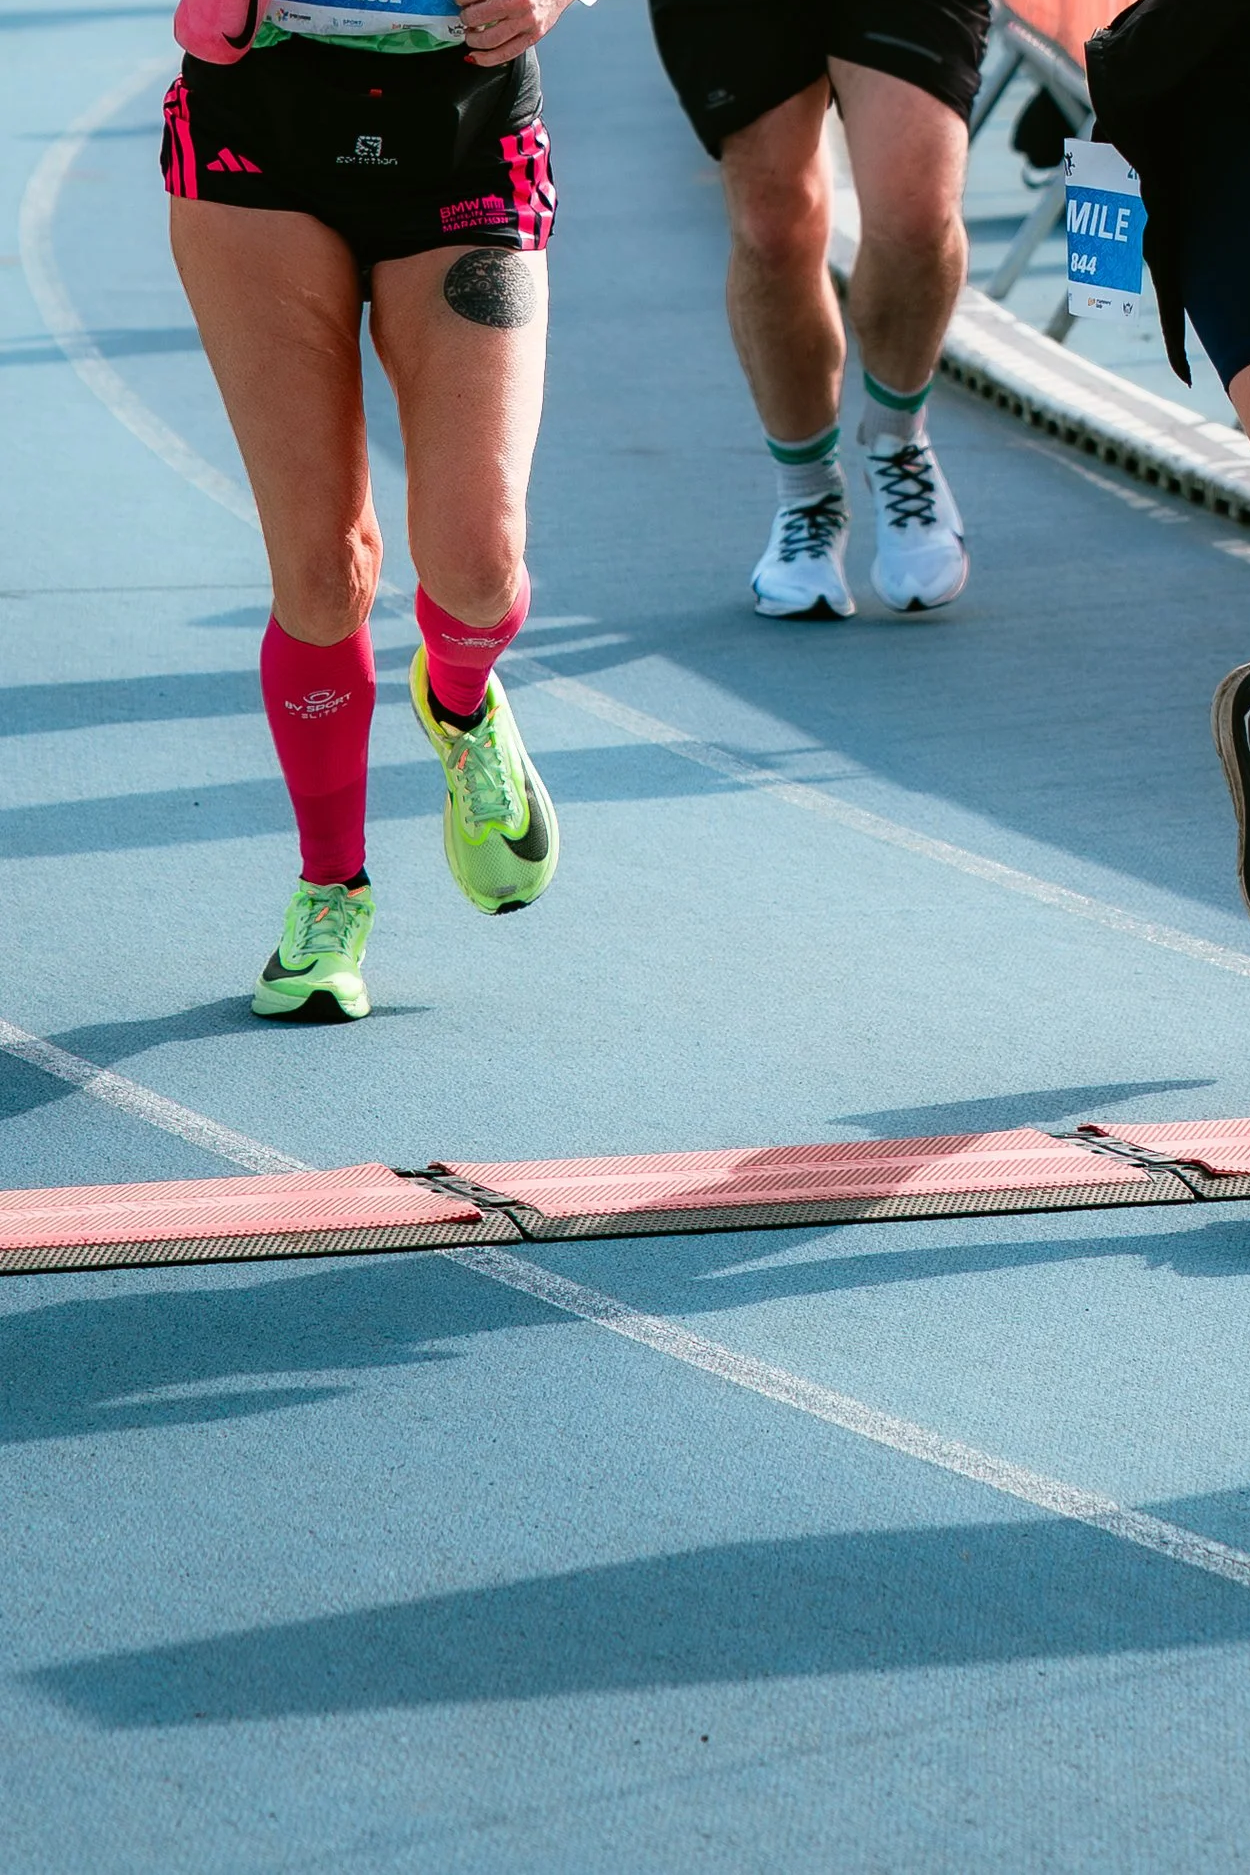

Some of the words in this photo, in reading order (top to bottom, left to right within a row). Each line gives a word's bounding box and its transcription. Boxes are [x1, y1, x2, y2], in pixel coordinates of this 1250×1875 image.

[440, 198, 480, 219] BMW
[443, 216, 509, 233] MARATHON
[1066, 199, 1131, 243] MILE
[1070, 252, 1097, 275] 844
[306, 692, 352, 713] SPORT
